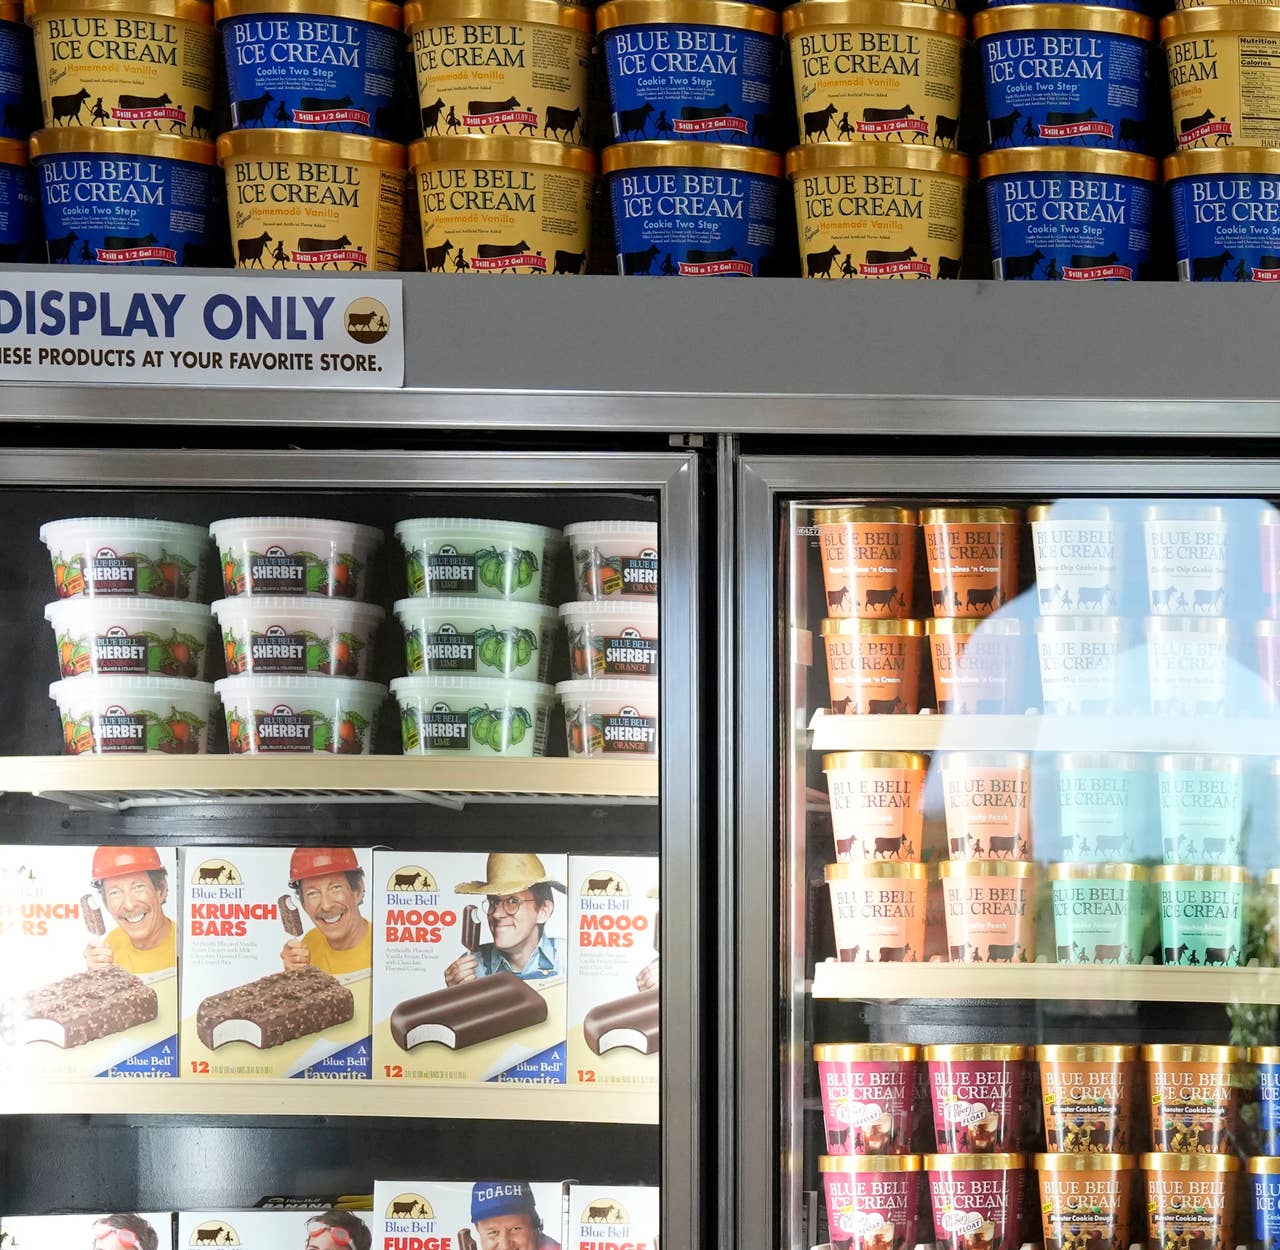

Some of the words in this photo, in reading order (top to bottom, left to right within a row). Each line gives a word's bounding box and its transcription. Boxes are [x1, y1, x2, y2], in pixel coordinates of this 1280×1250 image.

[622, 175, 676, 196] BLUE
[683, 175, 744, 197] BELL
[624, 198, 653, 218] ICE
[658, 196, 743, 219] CREAM
[644, 219, 672, 229] Cookie
[675, 219, 694, 228] Two
[698, 220, 718, 230] Step
[203, 294, 335, 340] ONLY
[38, 348, 135, 367] PRODUCTS
[142, 350, 164, 367] AT
[169, 351, 222, 369] YOUR
[229, 352, 313, 370] FAVORITE
[320, 354, 383, 372] STORE.
[611, 640, 631, 648] BLUE
[632, 640, 651, 649] BELL
[440, 659, 457, 667] LIME
[606, 650, 656, 663] SHERBET
[615, 663, 647, 672] ORANGE
[192, 888, 217, 899] Blue
[219, 888, 242, 899] Bell
[191, 904, 277, 920] KRUNCH
[386, 910, 456, 926] MOOO
[191, 921, 247, 937] BARS
[386, 927, 441, 943] BARS
[357, 1046, 367, 1054] A
[191, 1061, 209, 1073] 12
[323, 1057, 345, 1066] Blue
[347, 1056, 366, 1066] Bell
[303, 1068, 367, 1079] Favorite
[384, 1066, 402, 1077] 12
[1262, 1088, 1280, 1101] ICE
[478, 1185, 522, 1202] COACH
